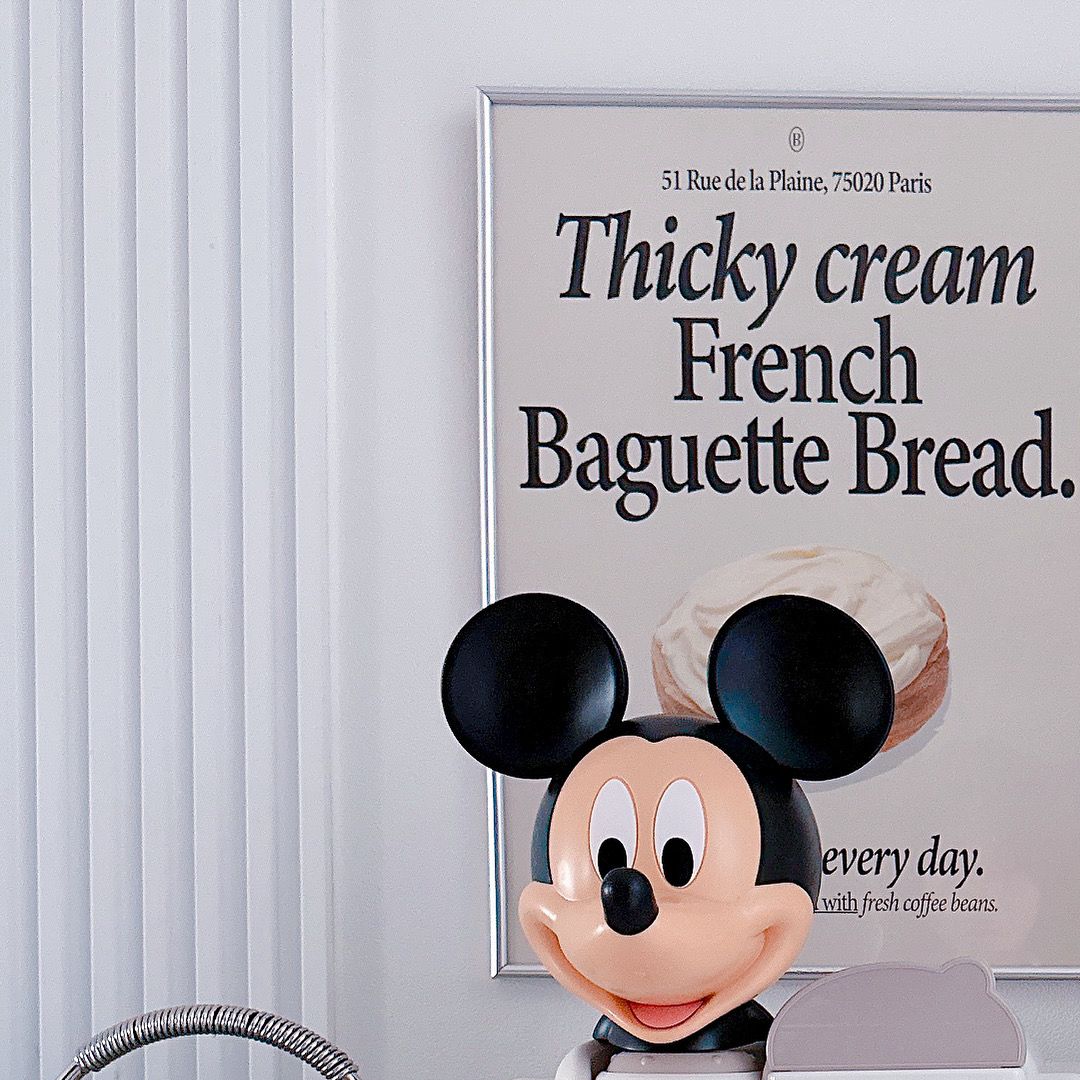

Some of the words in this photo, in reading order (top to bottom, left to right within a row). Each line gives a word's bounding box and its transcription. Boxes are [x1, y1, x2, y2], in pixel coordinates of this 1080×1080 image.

[662, 170, 680, 190] 51
[687, 169, 722, 191] Rue
[725, 169, 746, 191] de
[750, 169, 765, 191] la
[769, 169, 828, 195] Plaine,
[832, 171, 884, 193] 75020
[888, 171, 933, 194] Paris
[556, 210, 797, 330] Thicky
[815, 243, 1037, 305] cream
[673, 315, 923, 405] French
[518, 407, 829, 522] Baguette
[848, 408, 1076, 499] Bread.
[822, 847, 910, 888] every
[917, 834, 984, 888] day.
[822, 891, 859, 914] with
[859, 891, 899, 918] fresh
[903, 892, 947, 918] coffee
[951, 892, 998, 913] beans.
